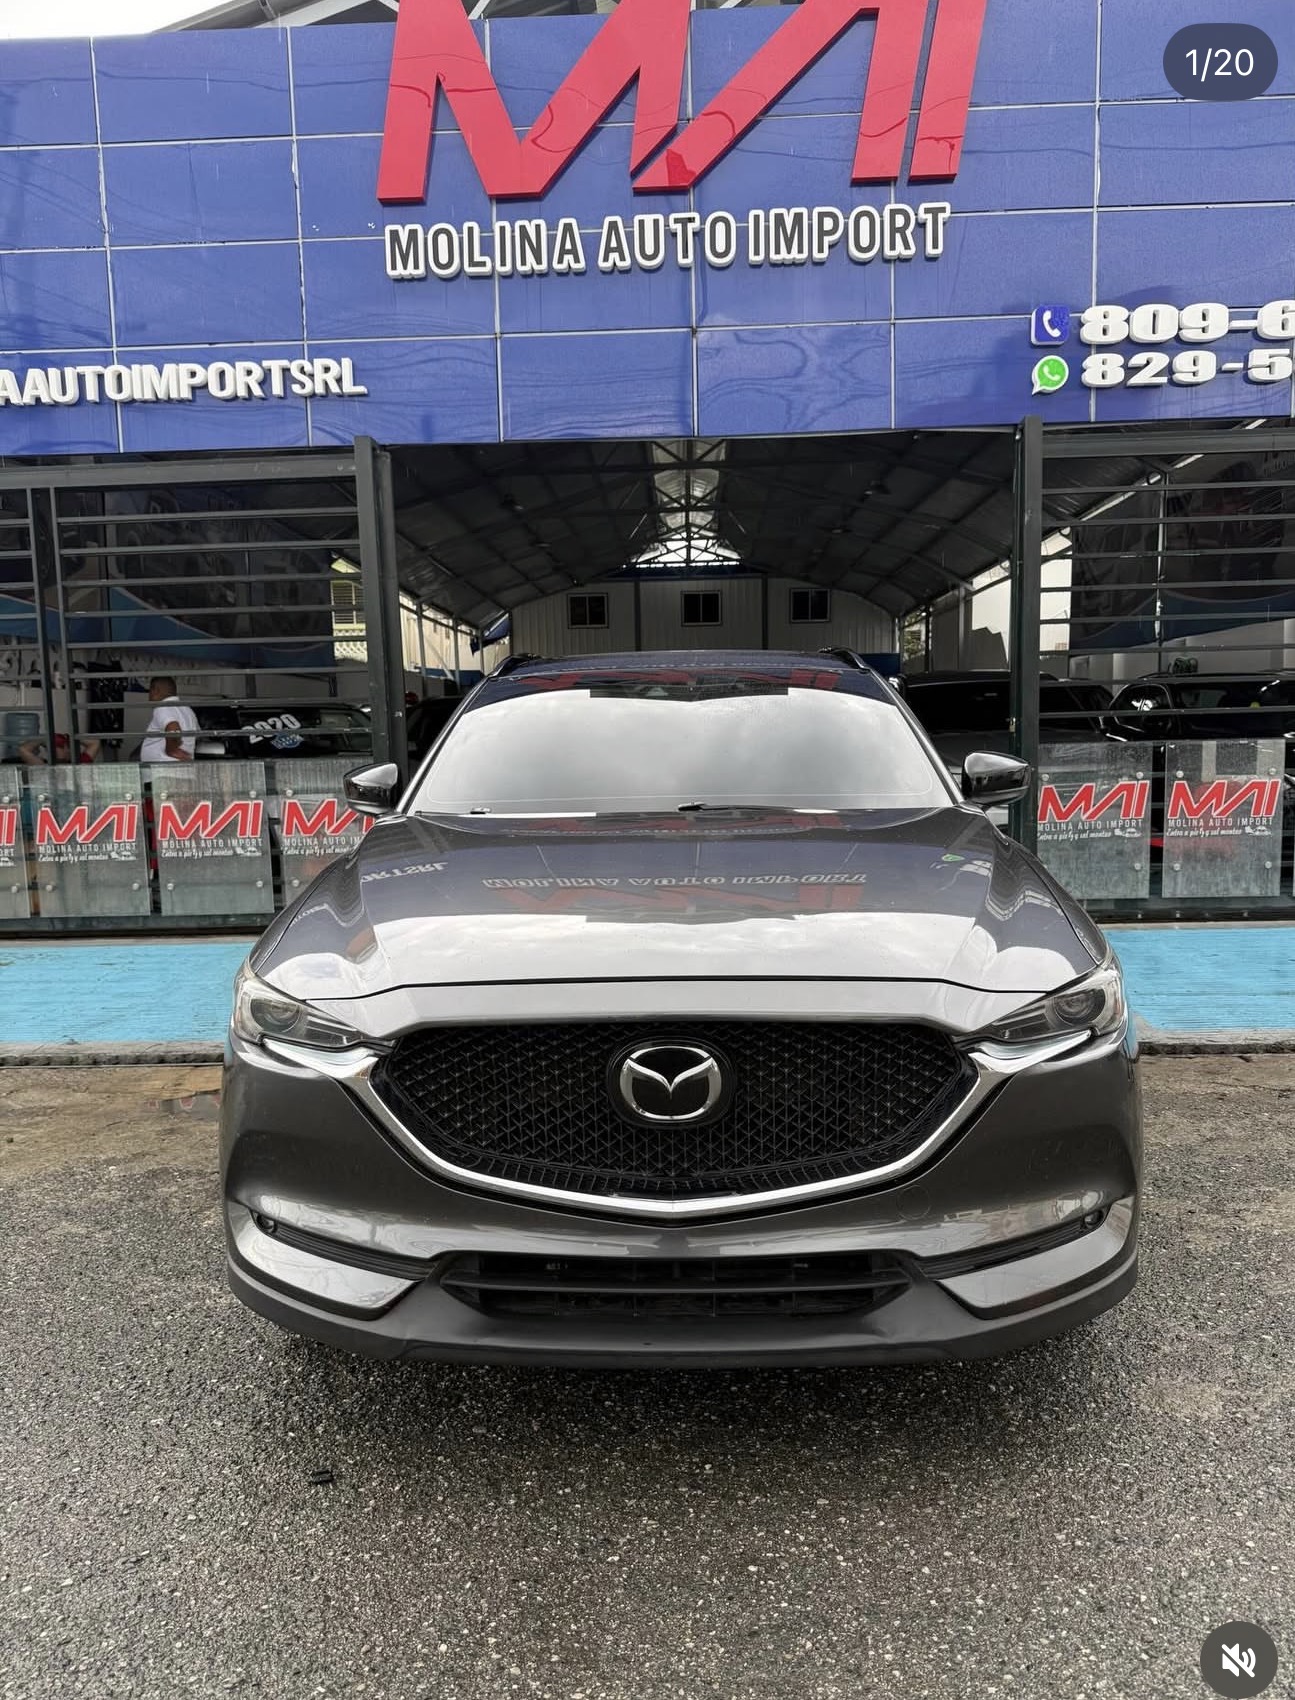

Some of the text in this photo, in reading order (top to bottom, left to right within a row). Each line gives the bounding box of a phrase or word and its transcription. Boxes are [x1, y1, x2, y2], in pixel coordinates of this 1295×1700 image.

[377, 0, 987, 204] MAI
[385, 202, 951, 279] MOLINA AUTO IMPORT
[1080, 300, 1295, 344] 809-6
[1081, 348, 1293, 388] 829-5
[1038, 780, 1150, 823] MAI
[1167, 779, 1281, 819] MAI
[36, 804, 138, 845] MAI
[159, 800, 263, 840] MAI
[1038, 820, 1143, 832] MOLINA AUTO IMPORT
[1168, 817, 1272, 827] MOLINA AUTO IMPORT
[39, 842, 137, 854] MOLINA AUTO IMPORT
[162, 838, 262, 848] MOLINA AUTO IMPORT
[284, 837, 319, 846] MOLINA
[323, 836, 346, 845] AUTO
